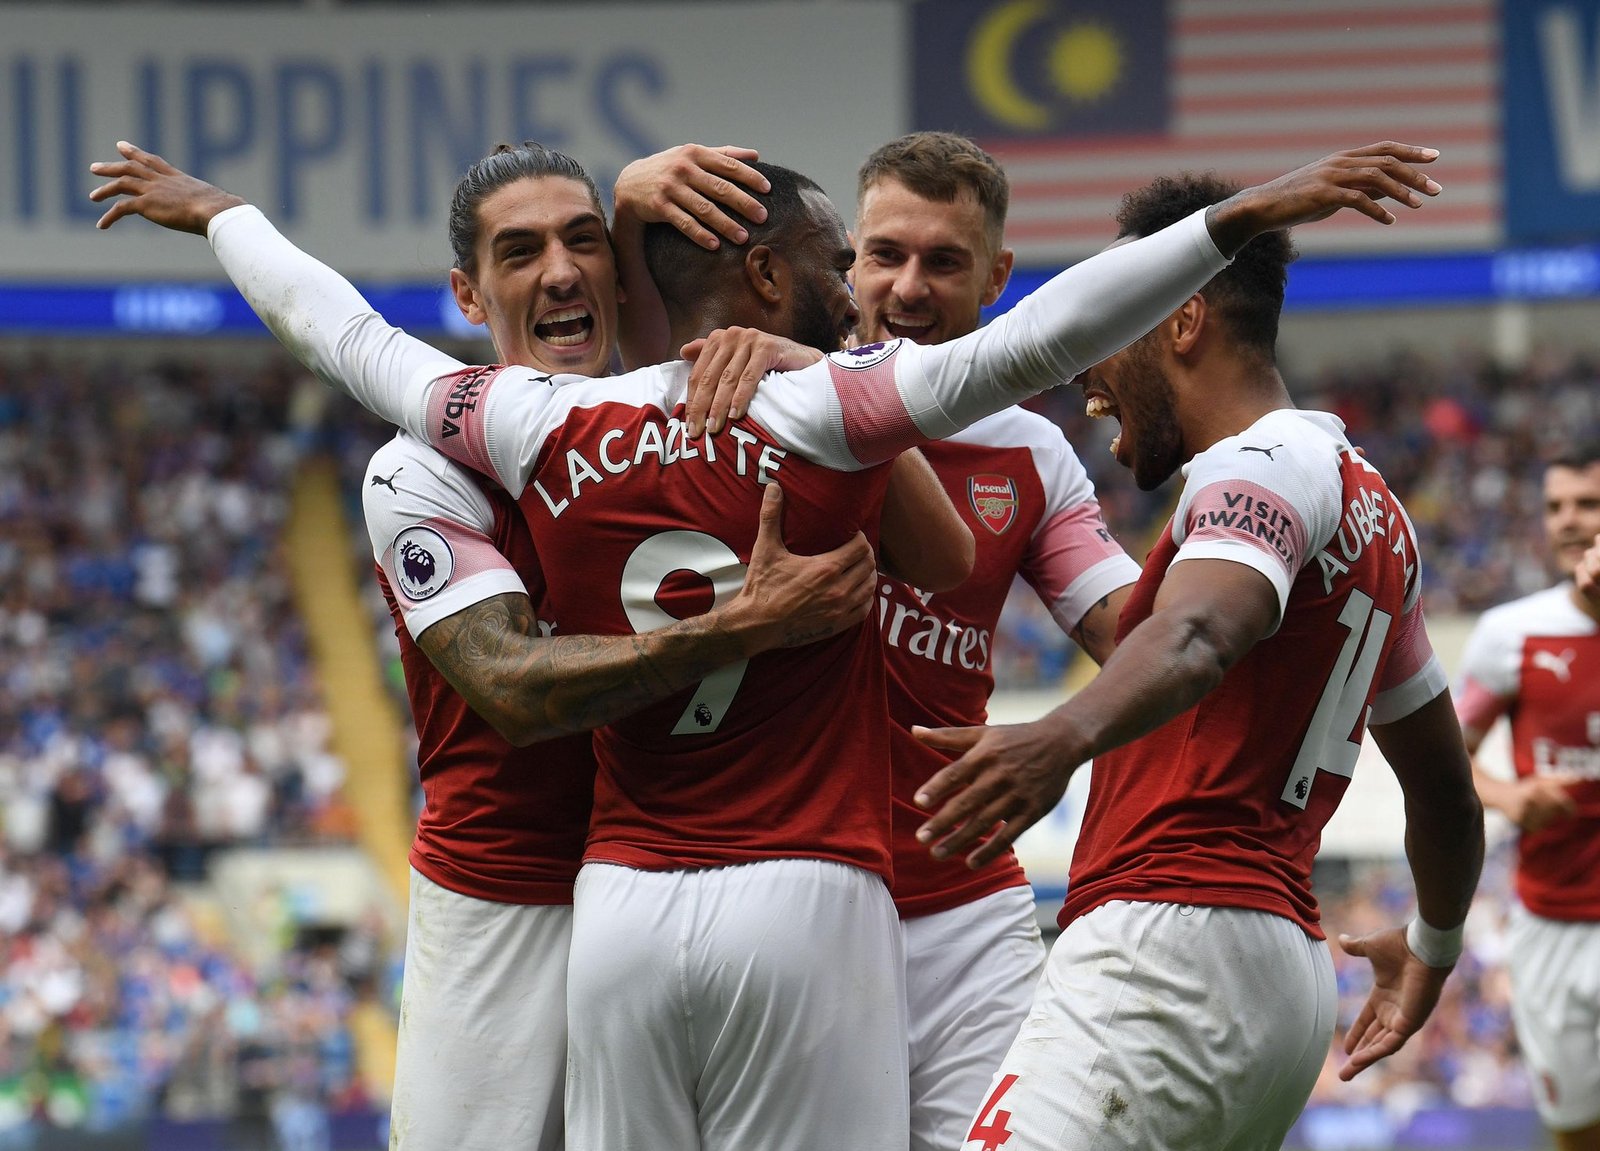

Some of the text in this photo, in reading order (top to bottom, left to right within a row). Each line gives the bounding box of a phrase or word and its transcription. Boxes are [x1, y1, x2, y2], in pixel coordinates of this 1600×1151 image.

[532, 417, 787, 519] LACAZETTE
[973, 483, 1010, 494] Arsenal
[1198, 510, 1294, 575] RWANDA
[1223, 491, 1292, 536] VISIT
[620, 529, 752, 736] 9
[1280, 587, 1393, 811] 14
